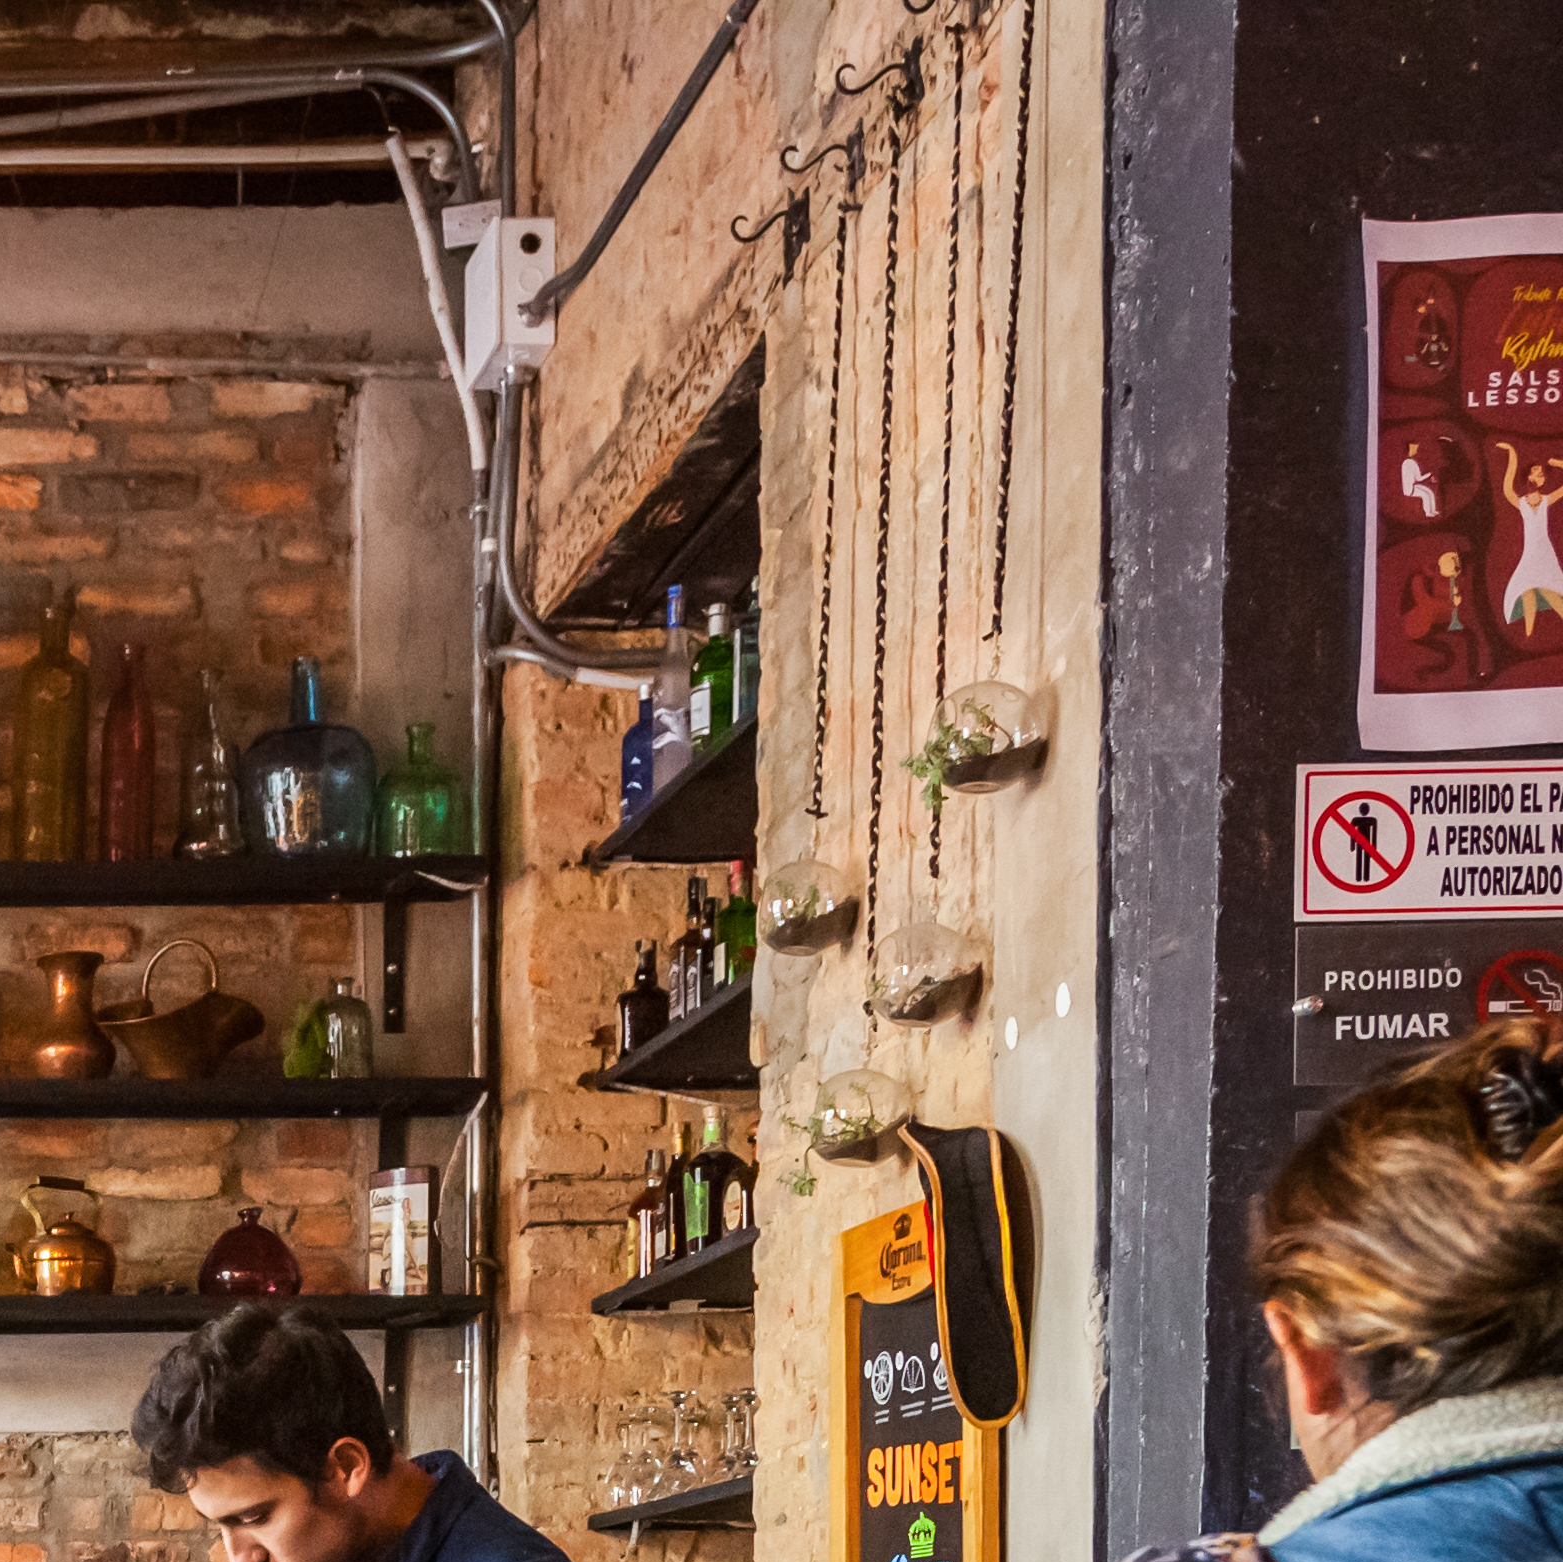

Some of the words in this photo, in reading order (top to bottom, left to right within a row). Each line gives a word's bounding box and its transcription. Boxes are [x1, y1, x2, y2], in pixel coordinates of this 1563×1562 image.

[1410, 784, 1514, 815] PROHIBIDO
[1520, 783, 1543, 813] EL
[1549, 782, 1563, 812] P
[1426, 826, 1439, 856] A
[1446, 825, 1545, 855] PERSONAL
[1440, 864, 1563, 897] AUTORIZADO
[1325, 967, 1462, 991] PROHIBIDO
[1335, 1012, 1450, 1040] FUMAR
